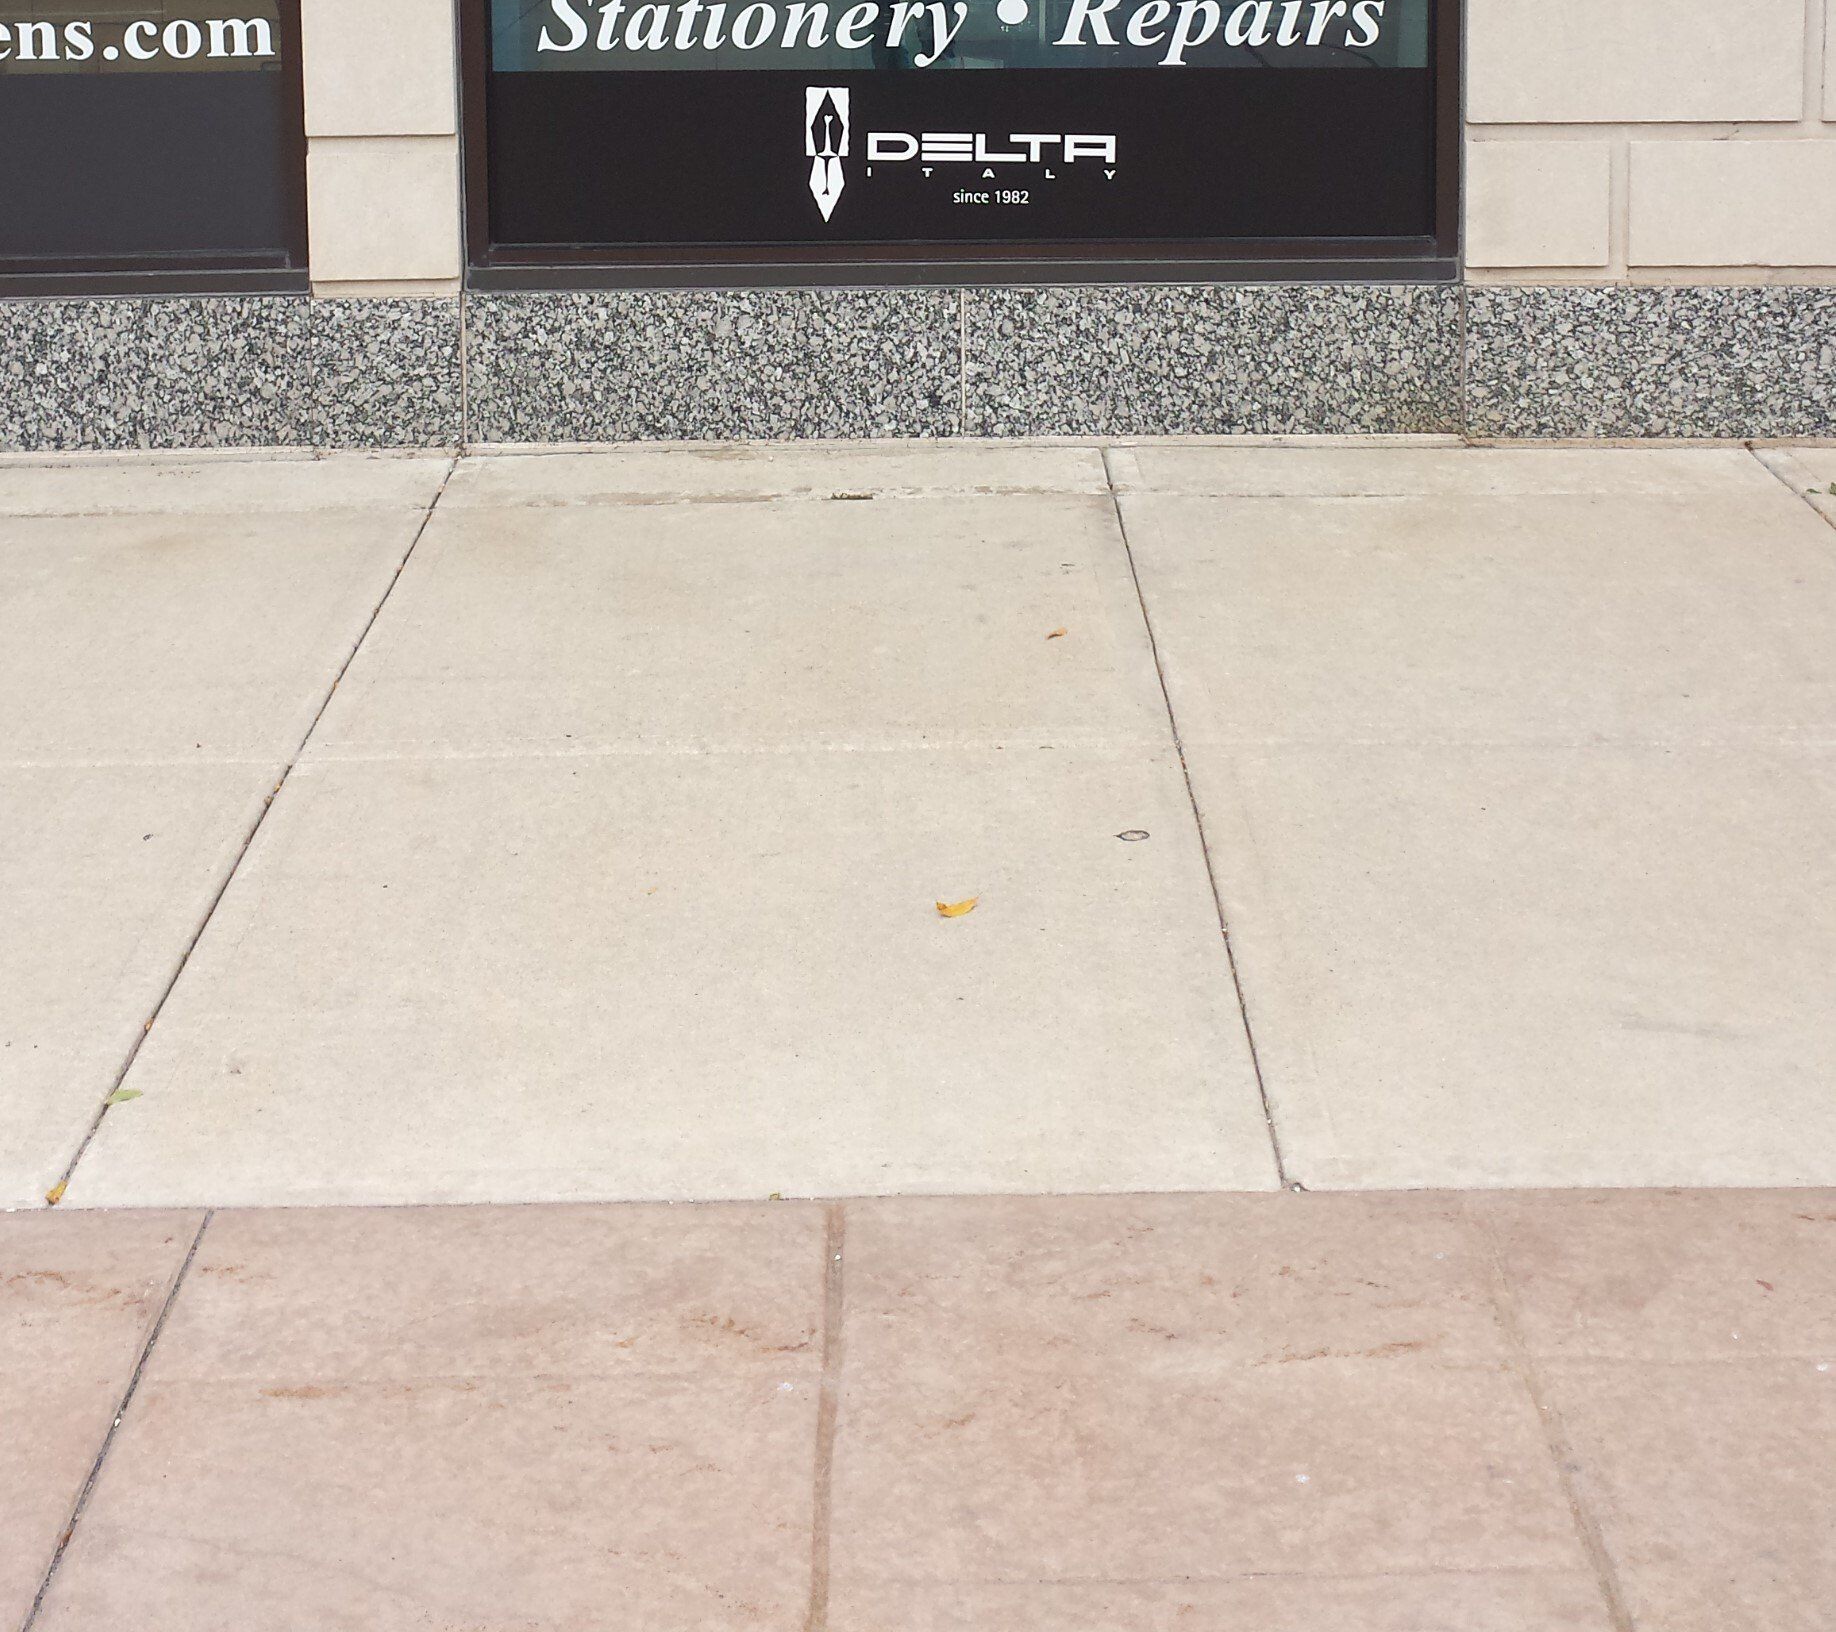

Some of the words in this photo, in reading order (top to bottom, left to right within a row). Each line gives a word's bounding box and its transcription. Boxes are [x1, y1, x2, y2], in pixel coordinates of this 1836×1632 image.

[867, 132, 1116, 164] DELTA
[867, 166, 1116, 181] ITALY
[953, 188, 989, 205] since
[994, 189, 1030, 205] 1982
